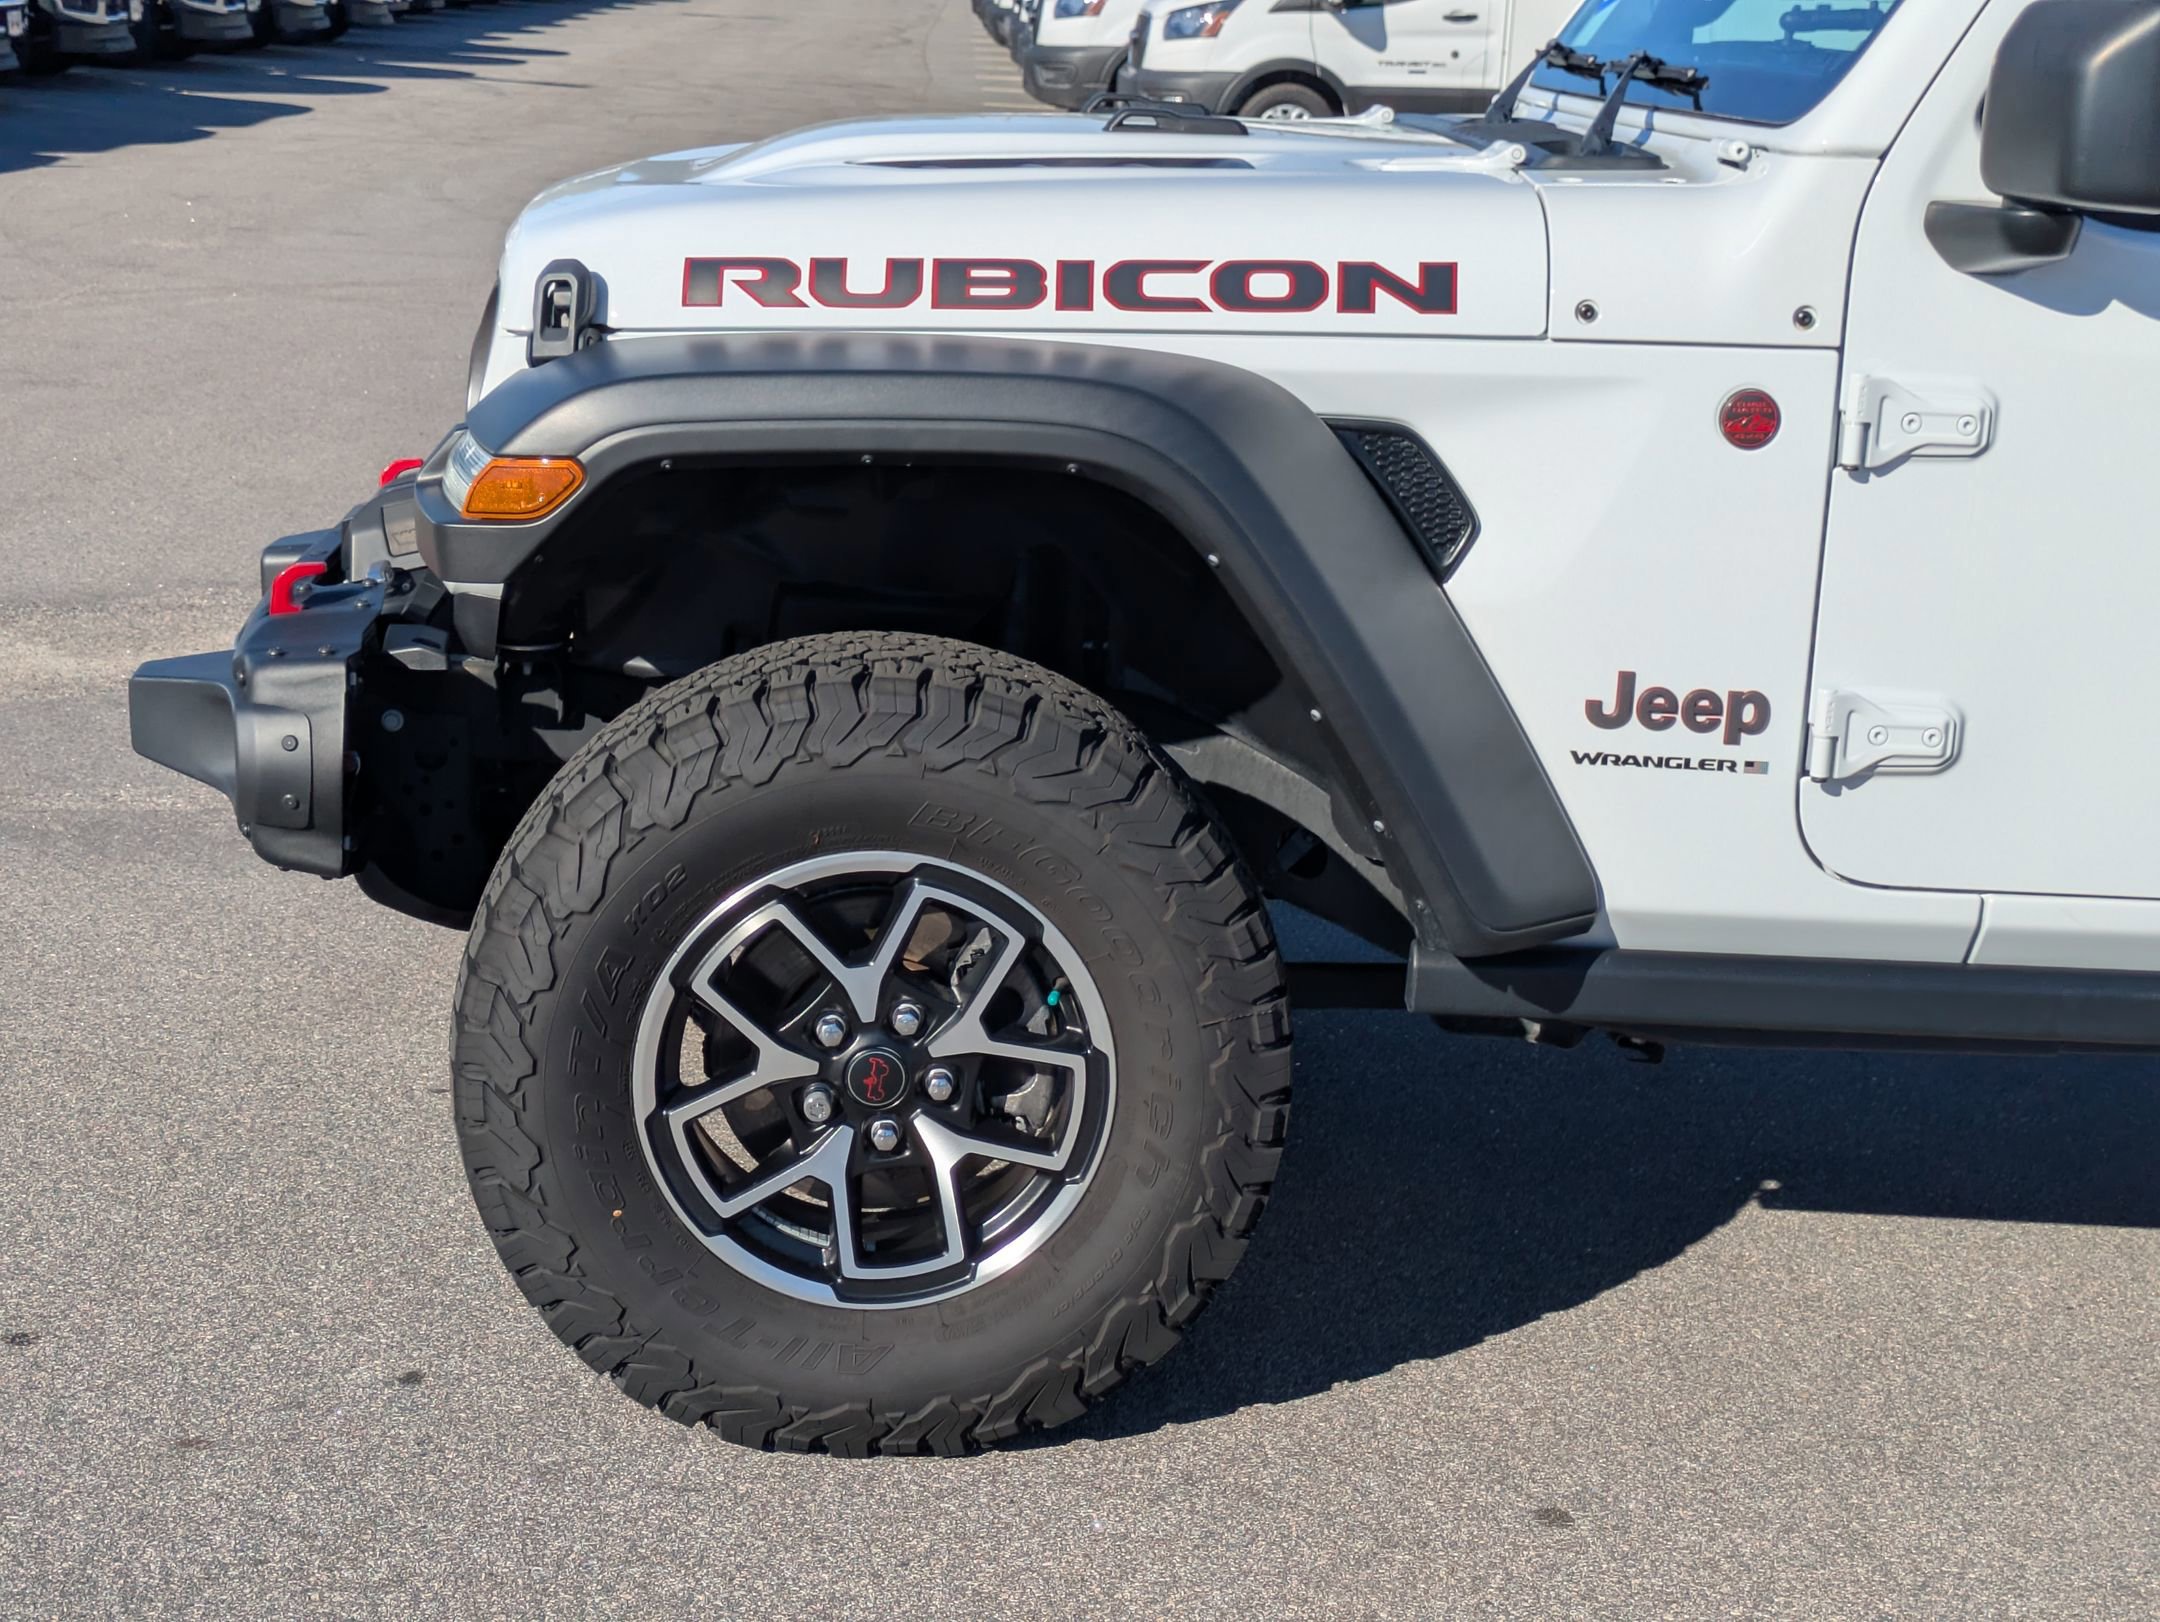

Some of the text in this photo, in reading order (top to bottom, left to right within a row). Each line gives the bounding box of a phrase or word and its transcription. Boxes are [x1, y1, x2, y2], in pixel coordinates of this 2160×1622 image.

[681, 257, 1458, 314] RUBICON
[1585, 670, 1772, 746] Jeep
[1570, 750, 1738, 773] WRANGLER
